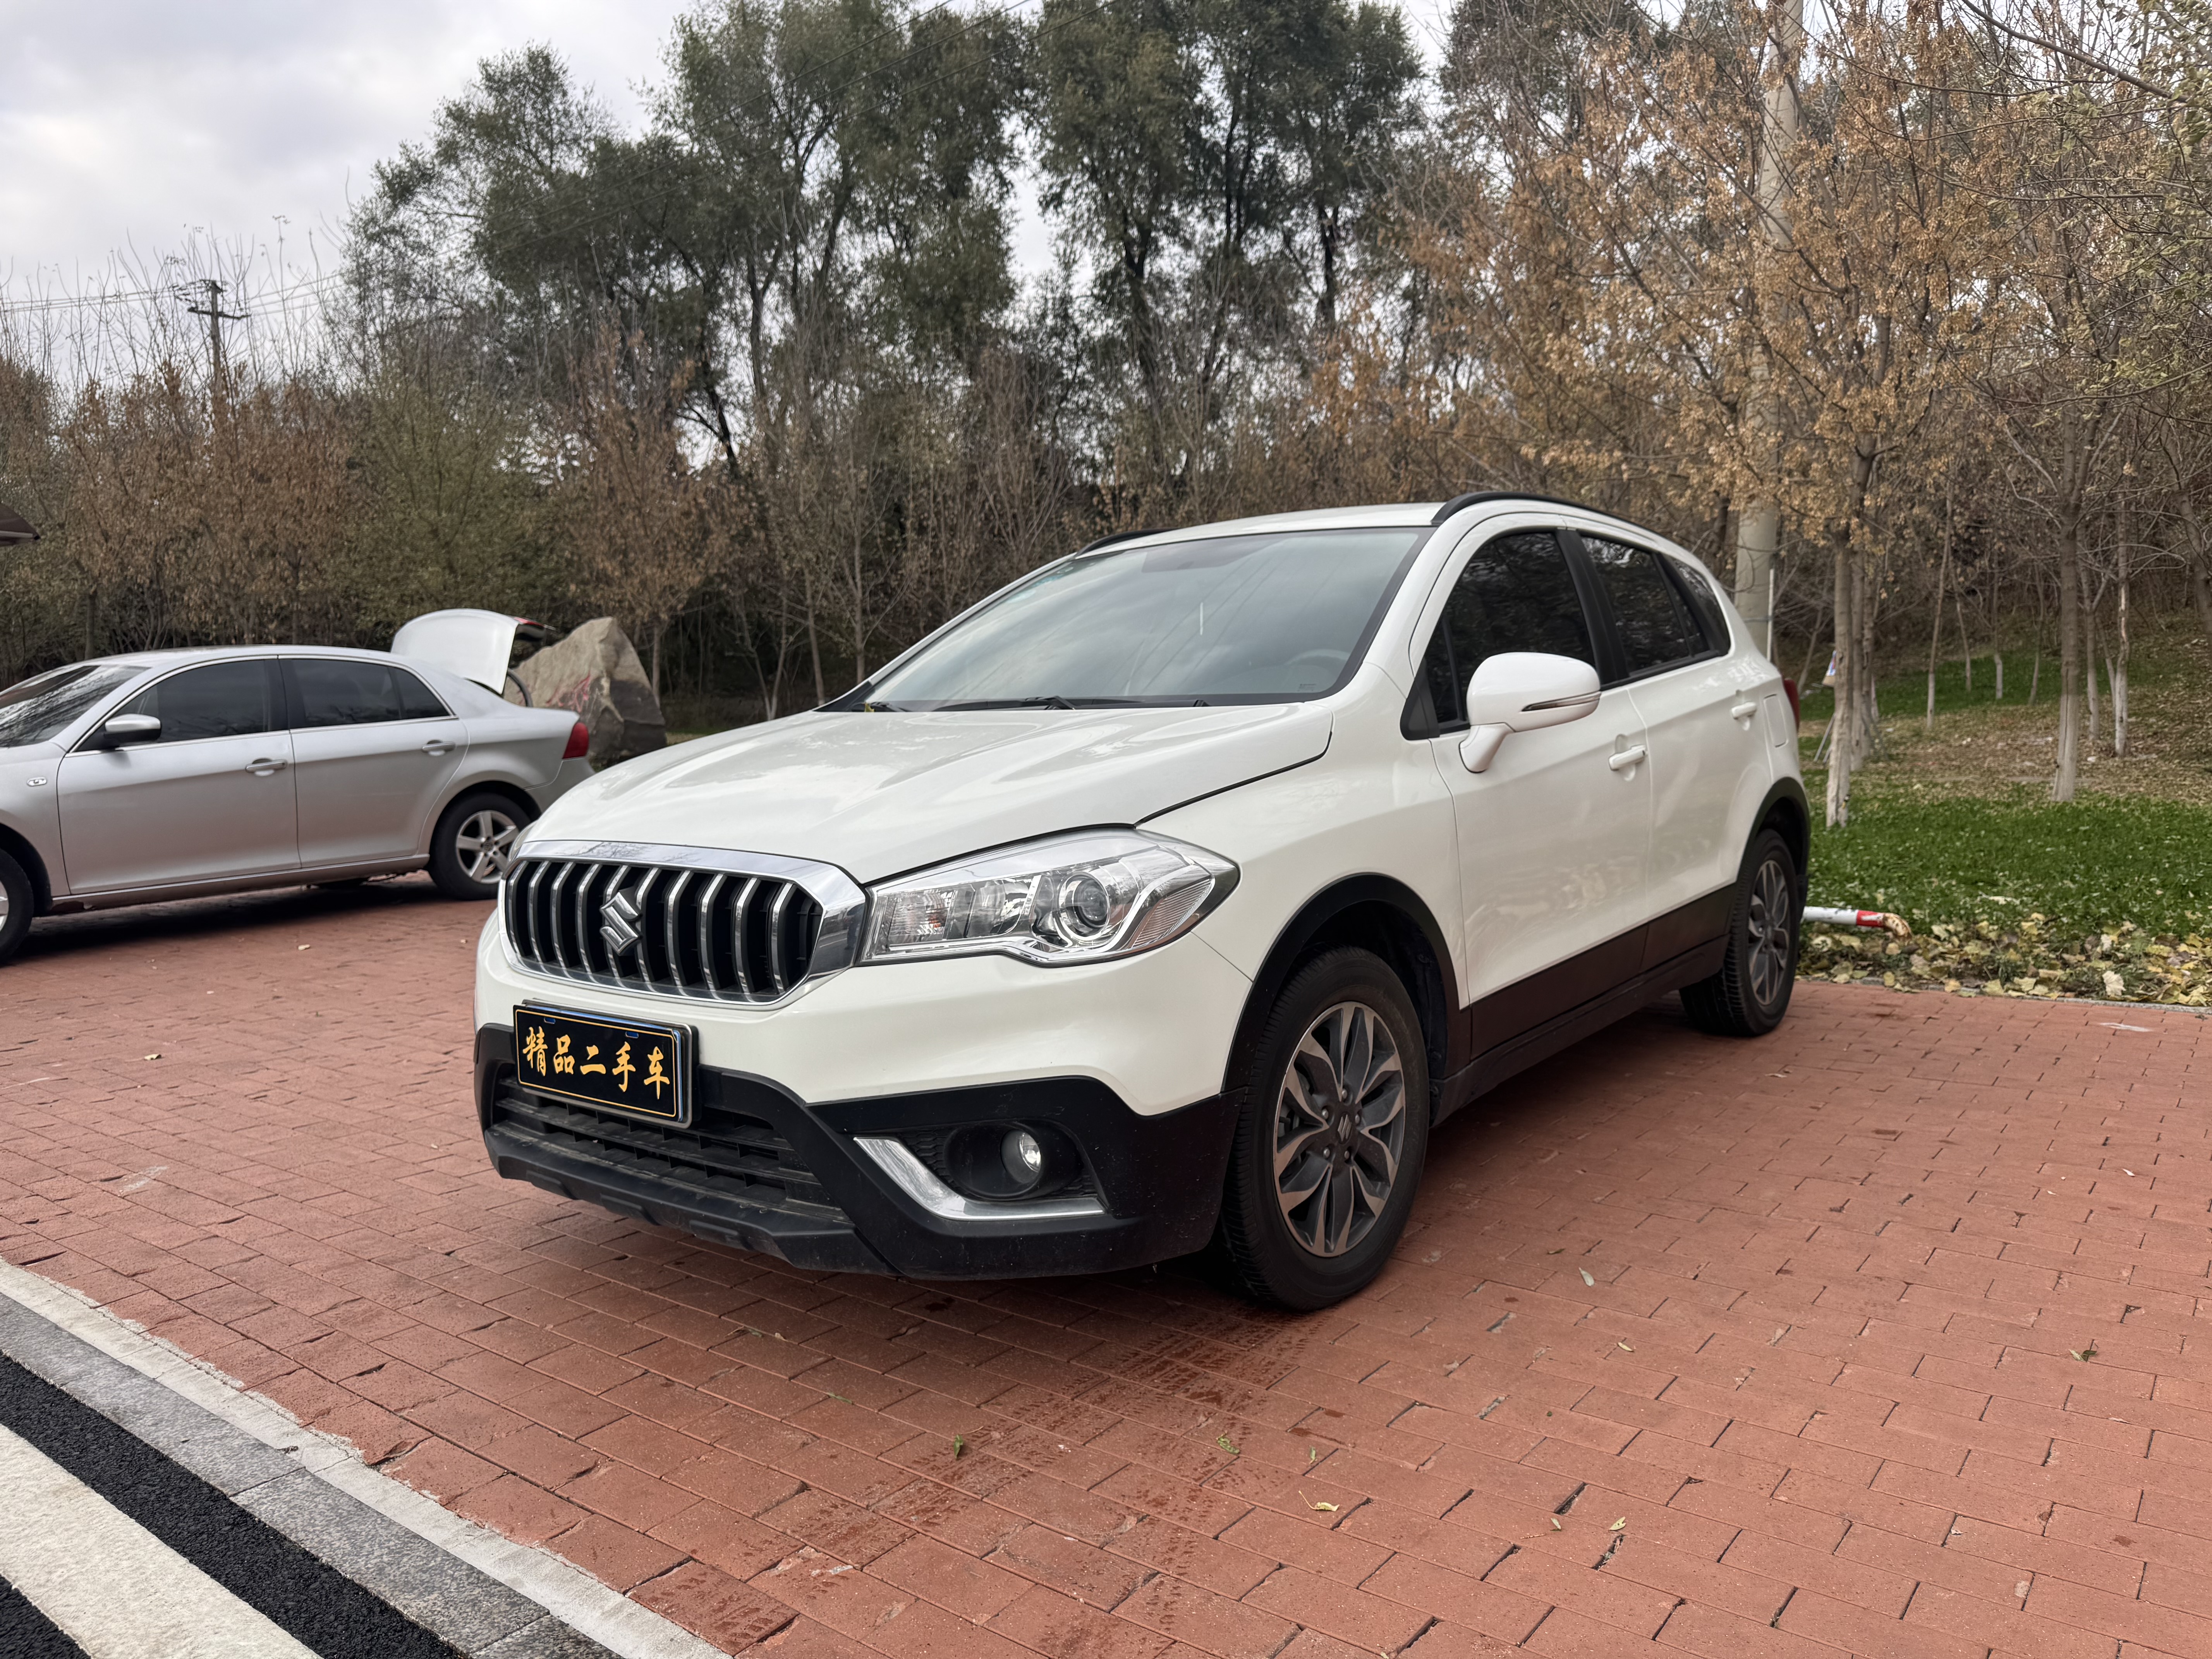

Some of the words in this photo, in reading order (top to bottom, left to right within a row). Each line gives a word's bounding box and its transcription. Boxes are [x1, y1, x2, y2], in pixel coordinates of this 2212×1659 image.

[522, 1026, 670, 1099] 精品二手车
